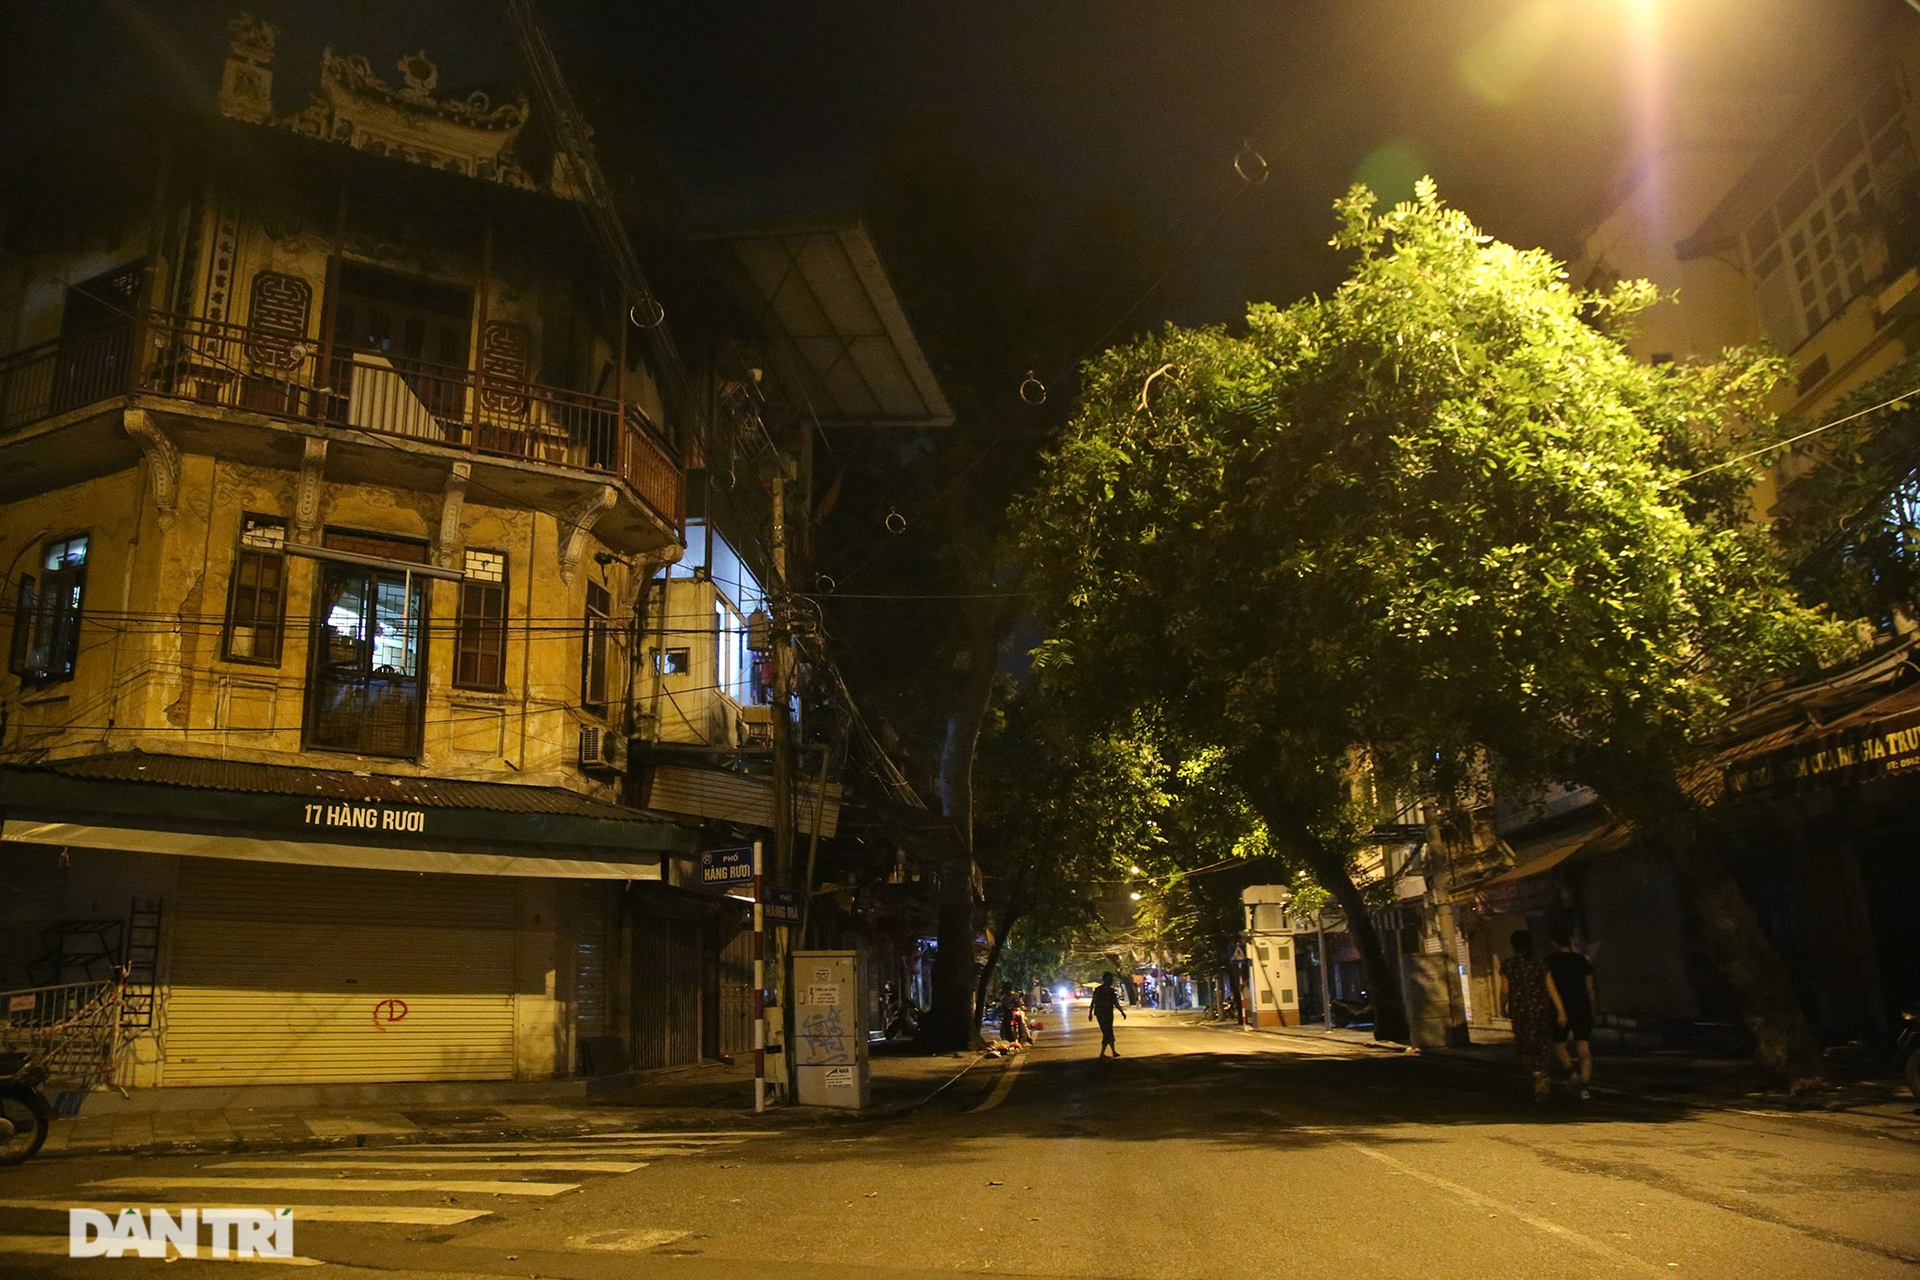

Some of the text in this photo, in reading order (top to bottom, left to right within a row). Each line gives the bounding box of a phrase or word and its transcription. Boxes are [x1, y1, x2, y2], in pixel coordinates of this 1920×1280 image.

[1860, 738, 1887, 762] GIA
[304, 802, 425, 833] 17 HÀNG RƯƠI
[722, 852, 739, 863] PHỐ
[704, 863, 751, 881] HÀNG RƯƠI
